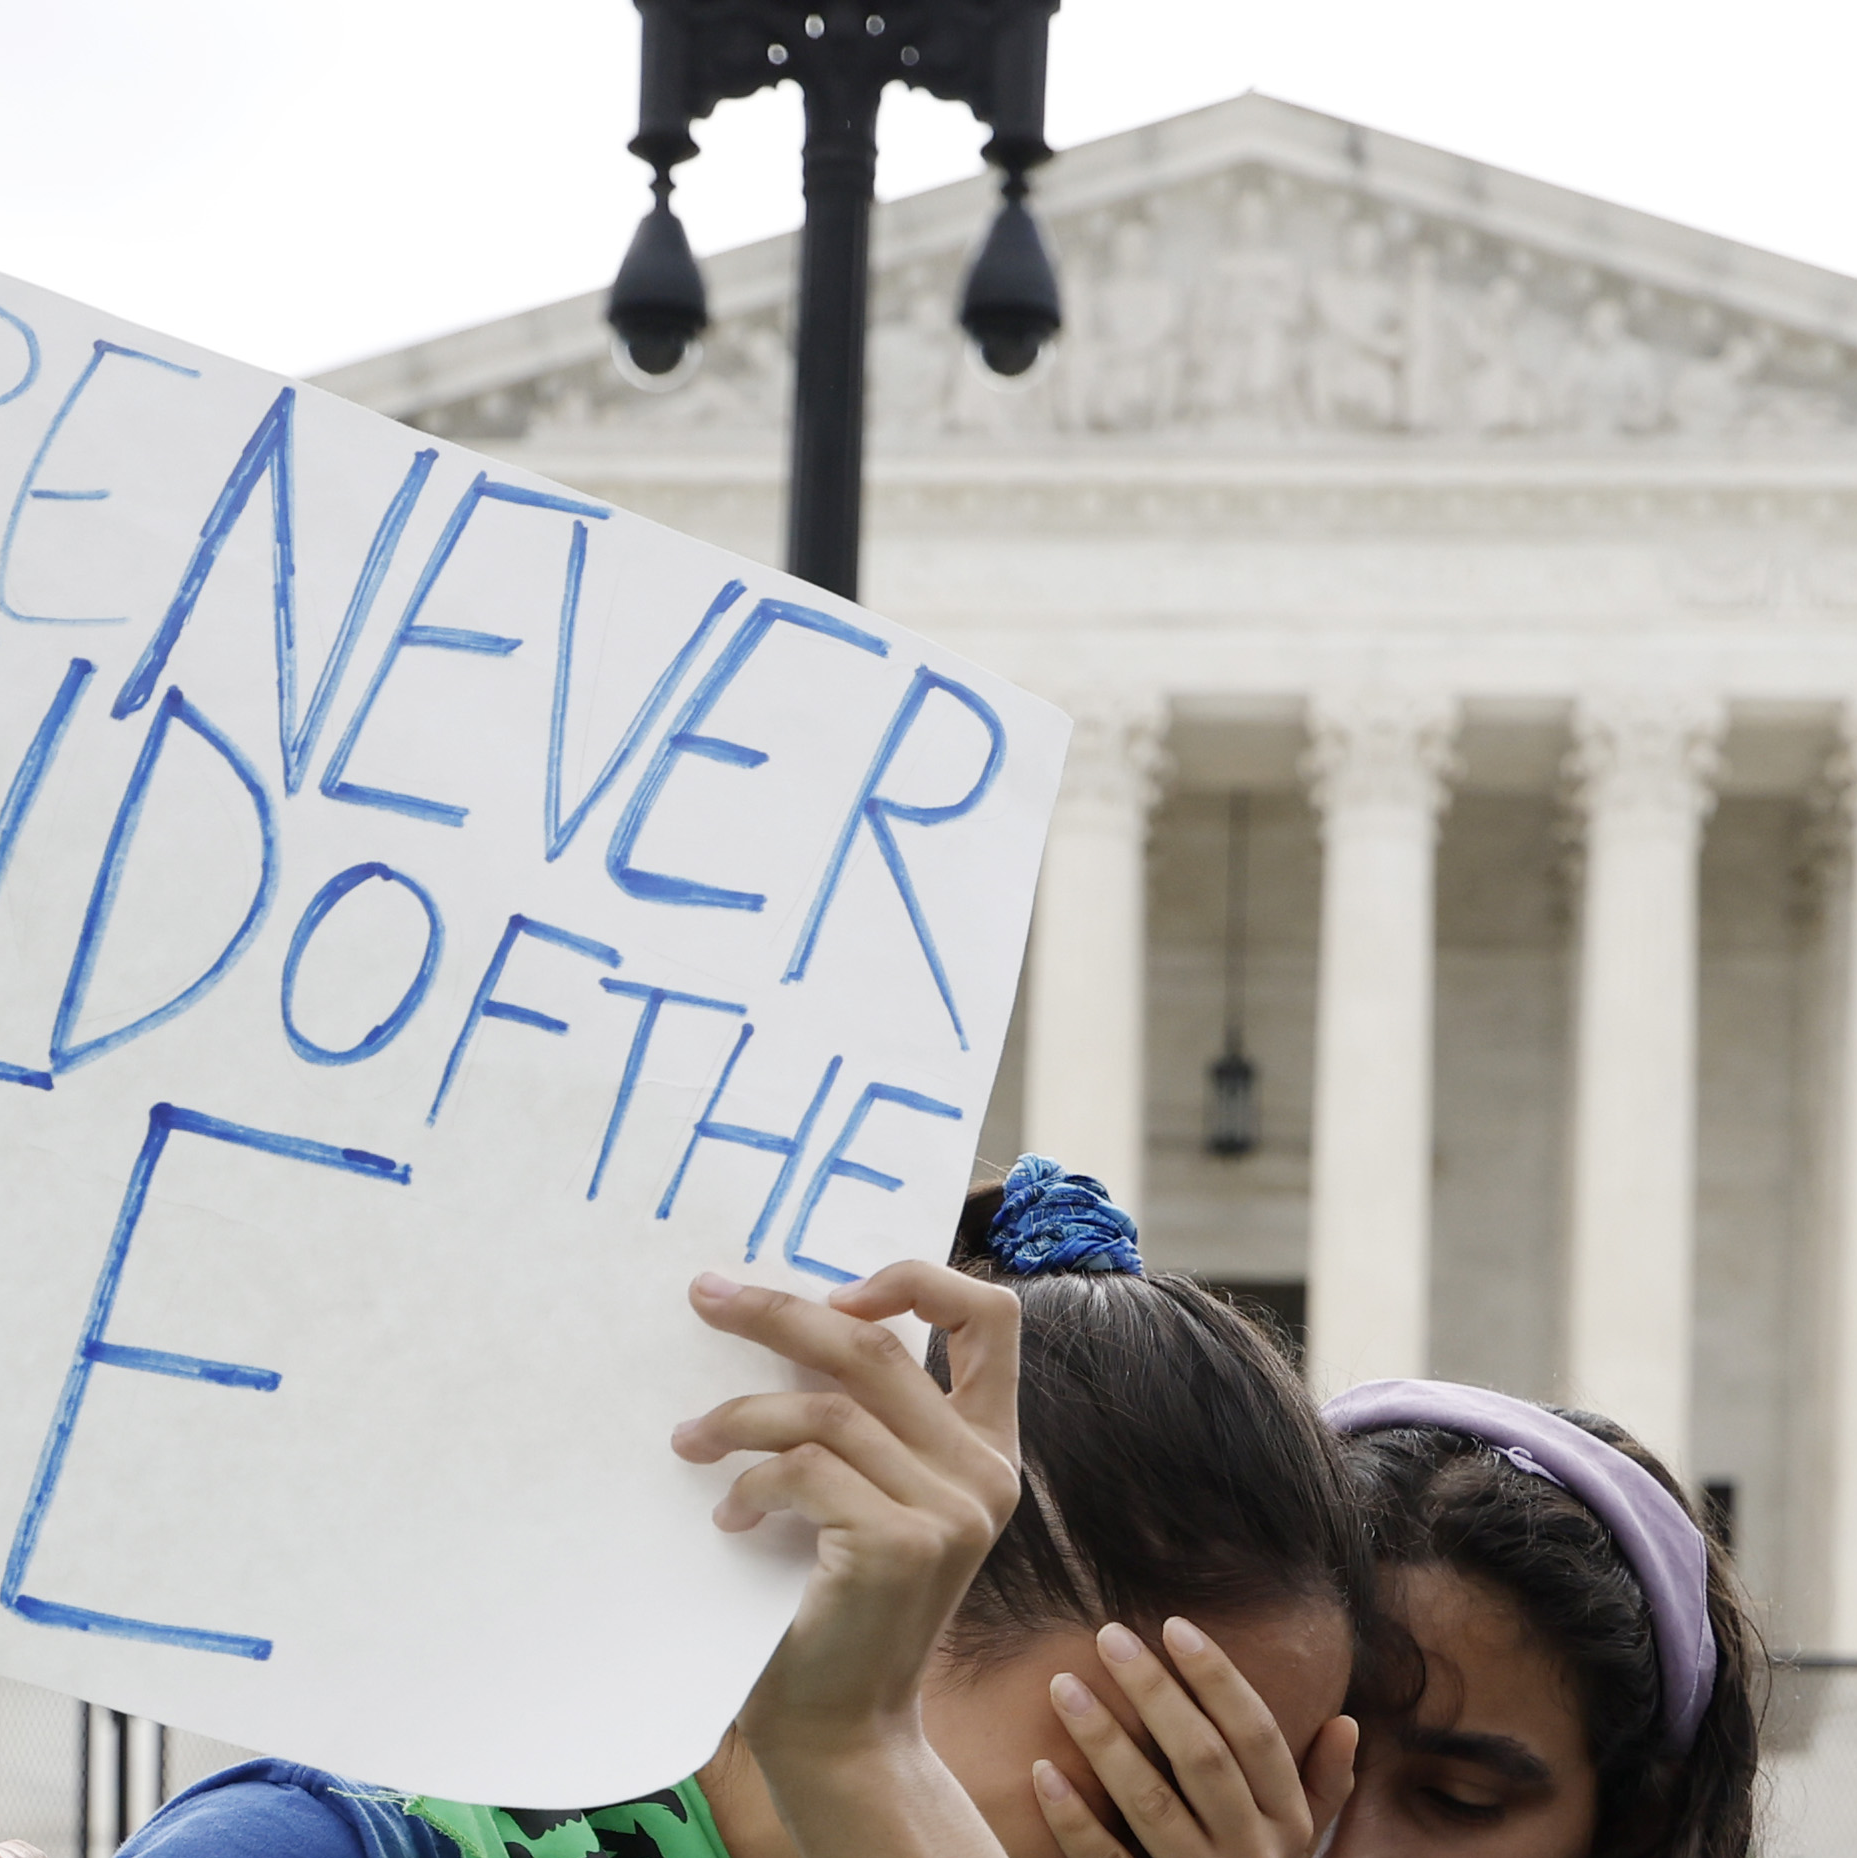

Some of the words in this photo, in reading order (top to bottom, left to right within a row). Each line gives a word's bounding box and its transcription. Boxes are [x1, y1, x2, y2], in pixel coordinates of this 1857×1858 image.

[112, 385, 1008, 1050] NEVER
[277, 860, 623, 1126] OF
[588, 978, 968, 1285] THE
